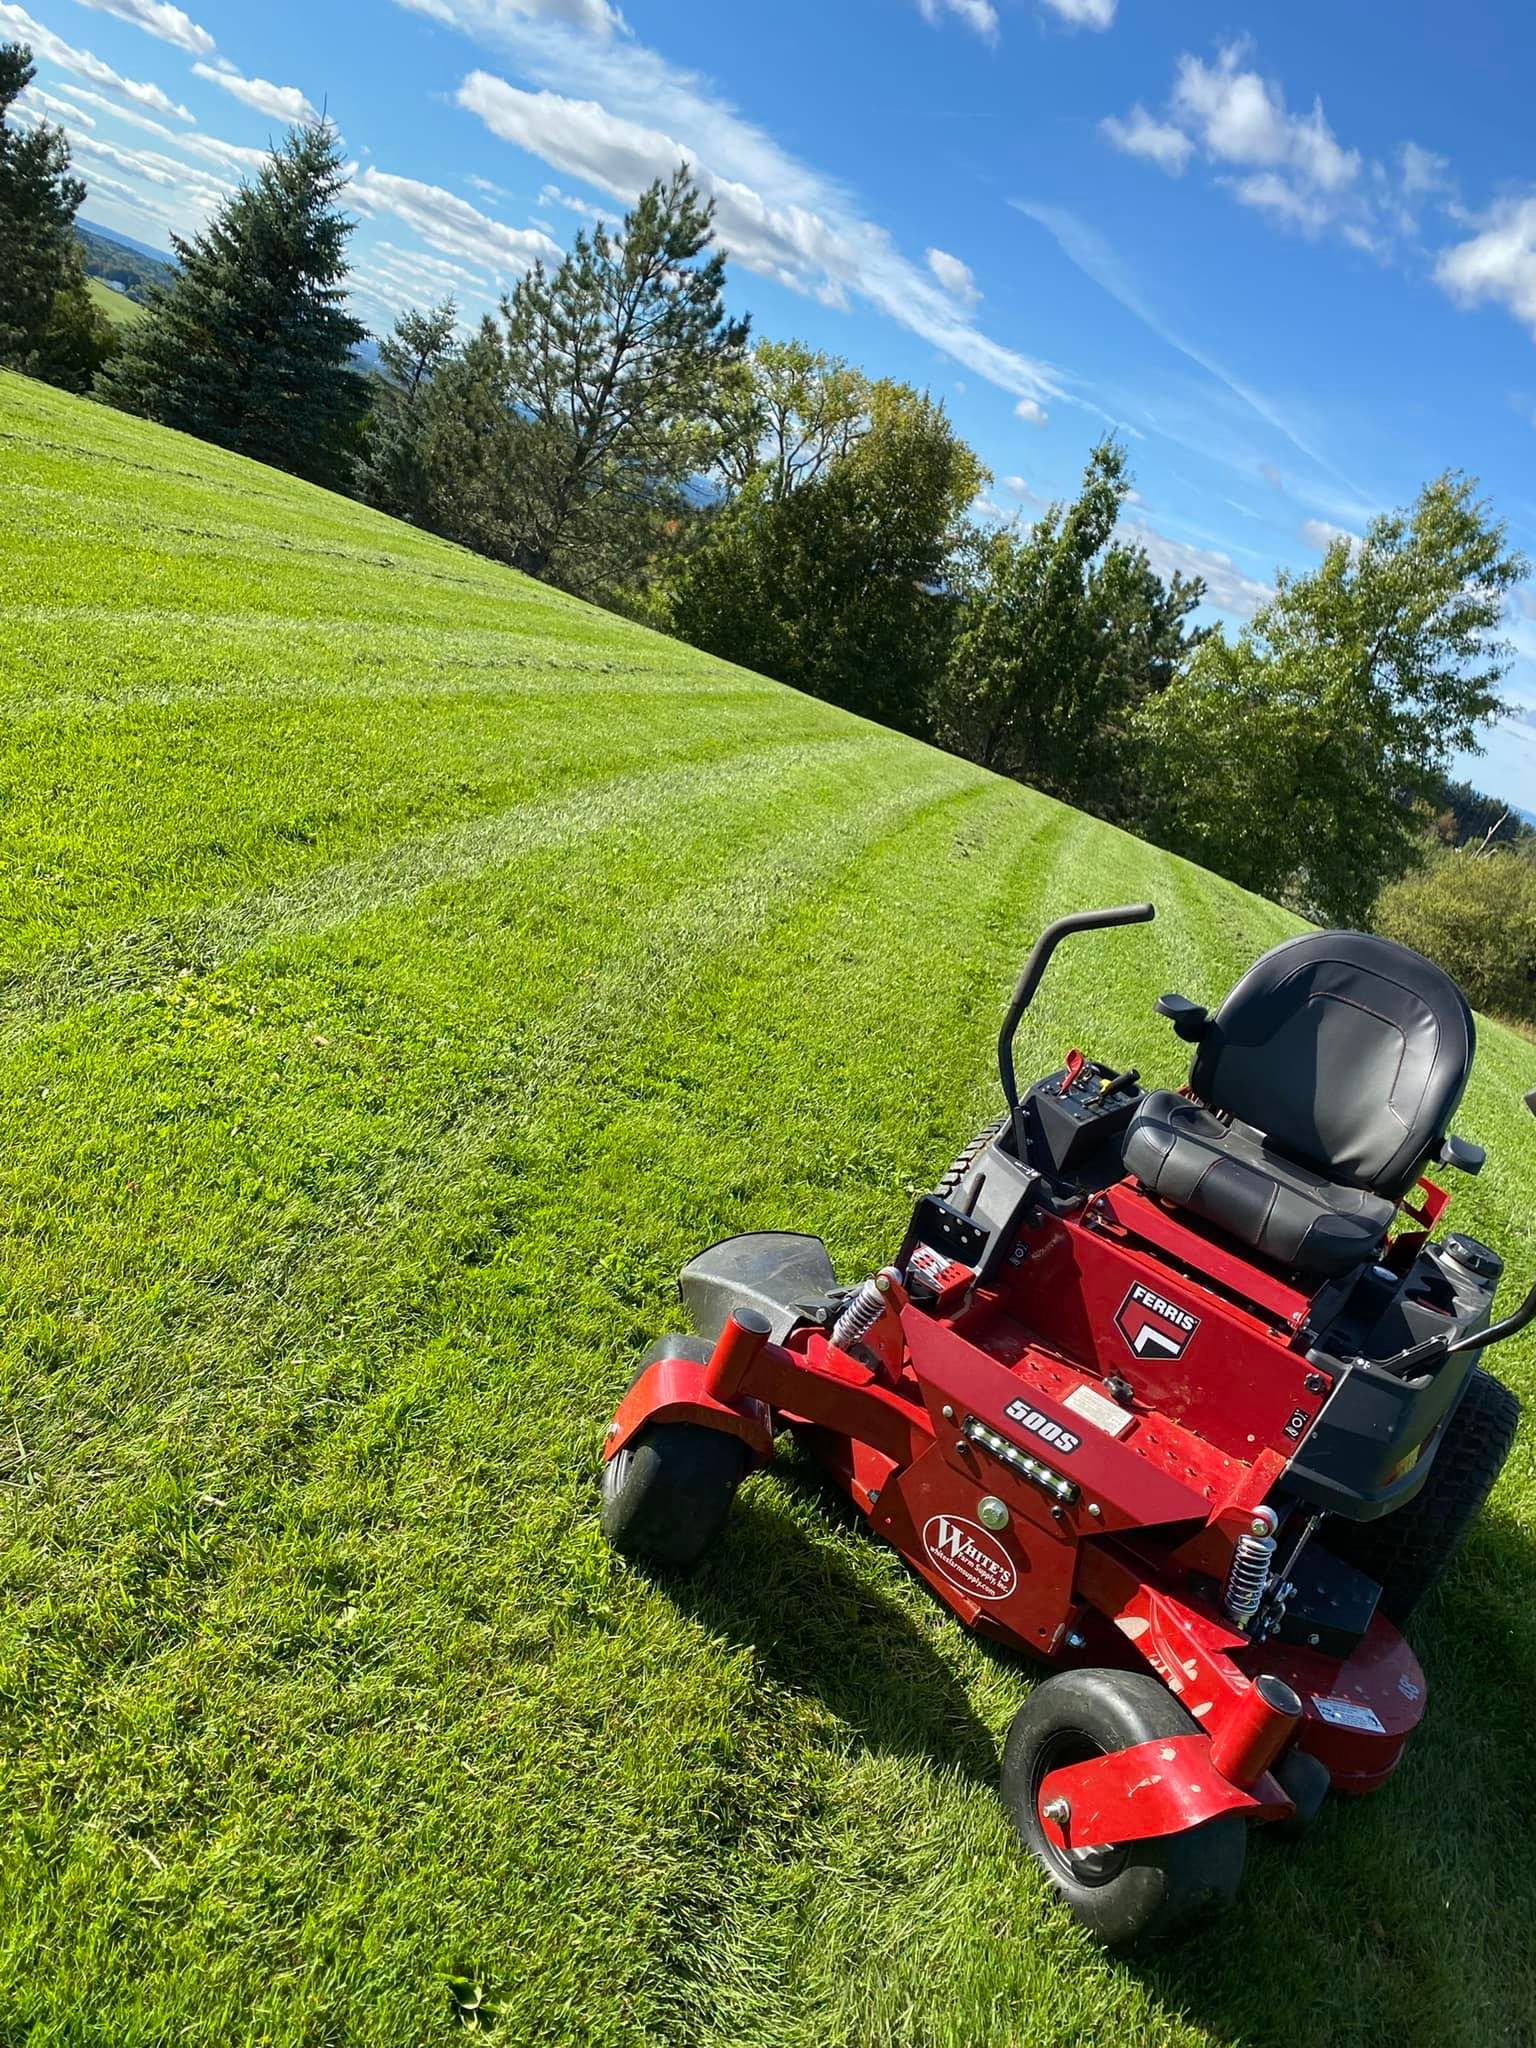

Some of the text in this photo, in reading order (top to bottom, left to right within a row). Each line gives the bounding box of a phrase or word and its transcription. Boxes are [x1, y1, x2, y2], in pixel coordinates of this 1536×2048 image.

[1132, 1286, 1195, 1330] FERRIS
[1005, 1400, 1079, 1452] 500S
[929, 1545, 996, 1597] whitesfarmsupply.com
[937, 1517, 1012, 1582] WHITE'S
[957, 1552, 975, 1568] Farm
[996, 1580, 1009, 1593] Inc.
